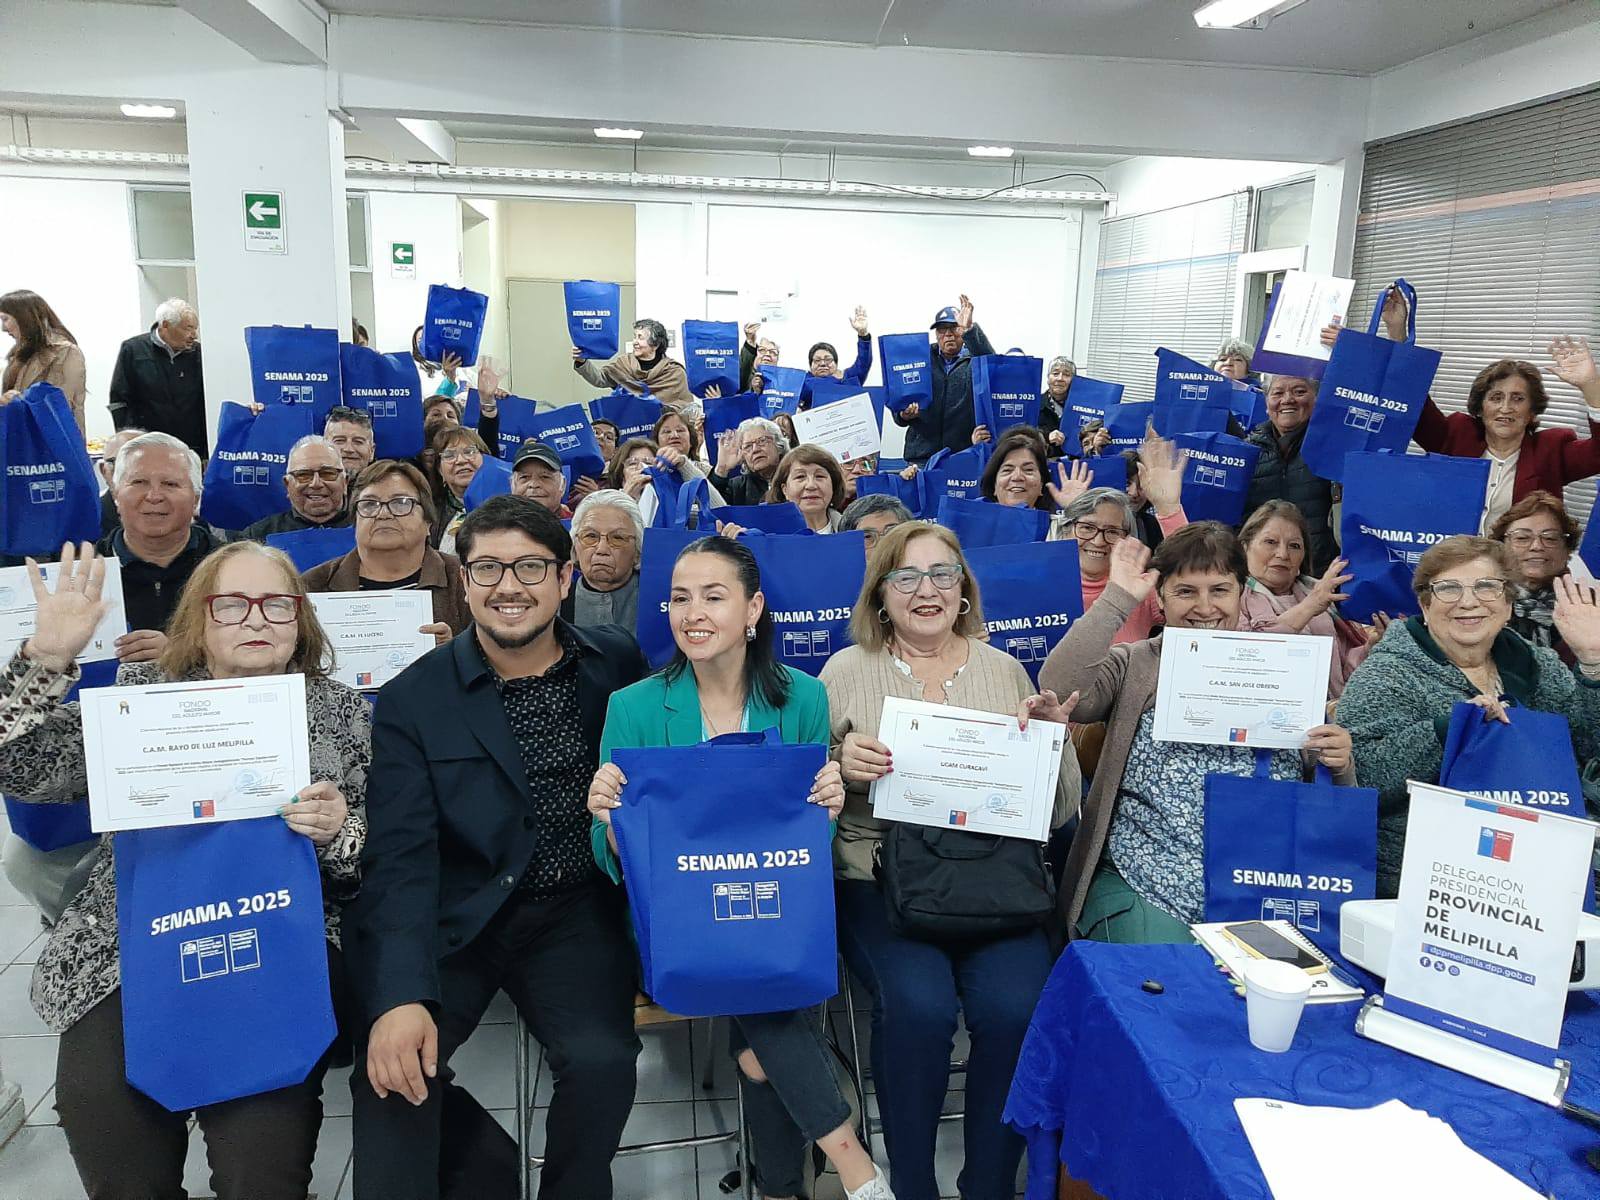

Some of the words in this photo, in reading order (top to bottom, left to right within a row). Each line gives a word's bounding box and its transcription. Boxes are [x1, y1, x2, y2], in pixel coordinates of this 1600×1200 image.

[265, 372, 303, 380] SENAMA
[306, 373, 328, 381] 2025
[1169, 372, 1202, 380] SENAMA
[1204, 372, 1225, 381] 2025
[1335, 387, 1378, 408] SENAMA
[1380, 399, 1408, 415] 2025
[502, 434, 520, 442] 2025
[539, 427, 567, 441] SENAMA
[567, 423, 583, 431] 2025
[219, 451, 259, 460] SENAMA
[262, 453, 286, 463] 2025
[1183, 448, 1219, 464] SENAMA
[1221, 456, 1245, 467] 2025
[818, 607, 851, 621] 2025
[1035, 614, 1067, 627] 2025
[142, 744, 167, 753] C.A.M.
[168, 743, 189, 752] RAYO
[191, 742, 200, 750] DE
[202, 740, 216, 750] LUZ
[217, 738, 255, 748] MELIPILLA
[1527, 791, 1569, 805] 2025
[678, 853, 758, 871] SENAMA
[763, 849, 810, 867] 2025
[1233, 870, 1302, 888] SENAMA
[1307, 876, 1352, 893] 2025
[1432, 861, 1524, 894] DELEGACIÓN
[1430, 874, 1528, 910] PRESIDENCIAL
[150, 901, 234, 936] SENAMA
[237, 889, 291, 916] 2025
[1426, 905, 1450, 922] DE
[1429, 889, 1545, 932] PROVINCIAL
[1423, 922, 1520, 960] MELIPILLA
